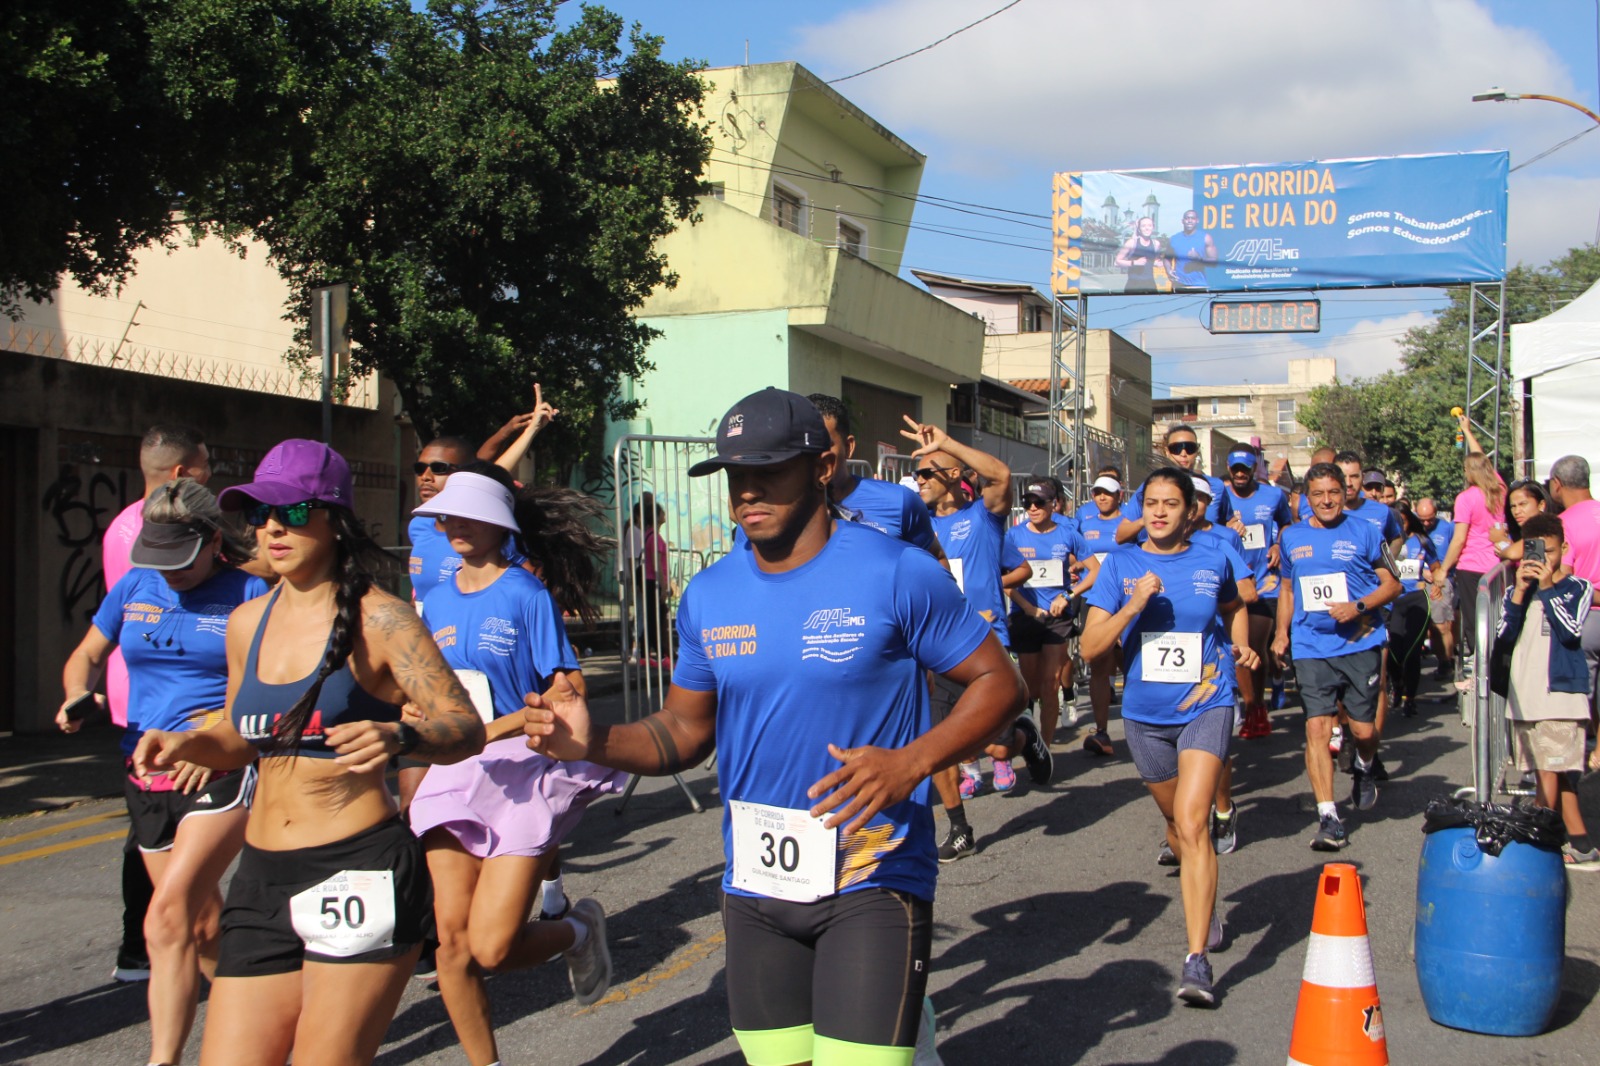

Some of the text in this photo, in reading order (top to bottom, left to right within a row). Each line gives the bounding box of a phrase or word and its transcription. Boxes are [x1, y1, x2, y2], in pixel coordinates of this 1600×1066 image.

[1203, 168, 1336, 199] 5ª CORRIDA
[1203, 199, 1337, 229] DE RUA DO
[1393, 227, 1471, 245] Educadores!
[1039, 567, 1047, 578] 2
[1313, 585, 1333, 600] 90
[711, 623, 757, 641] CORRIDA
[715, 642, 737, 658] RUA
[740, 640, 757, 655] DO
[1157, 647, 1186, 668] 73
[761, 809, 785, 822] CORRIDA
[776, 821, 786, 831] DO
[760, 831, 800, 873] 30
[752, 867, 811, 885] GUILHERME SANTIAGO
[320, 894, 366, 930] 50
